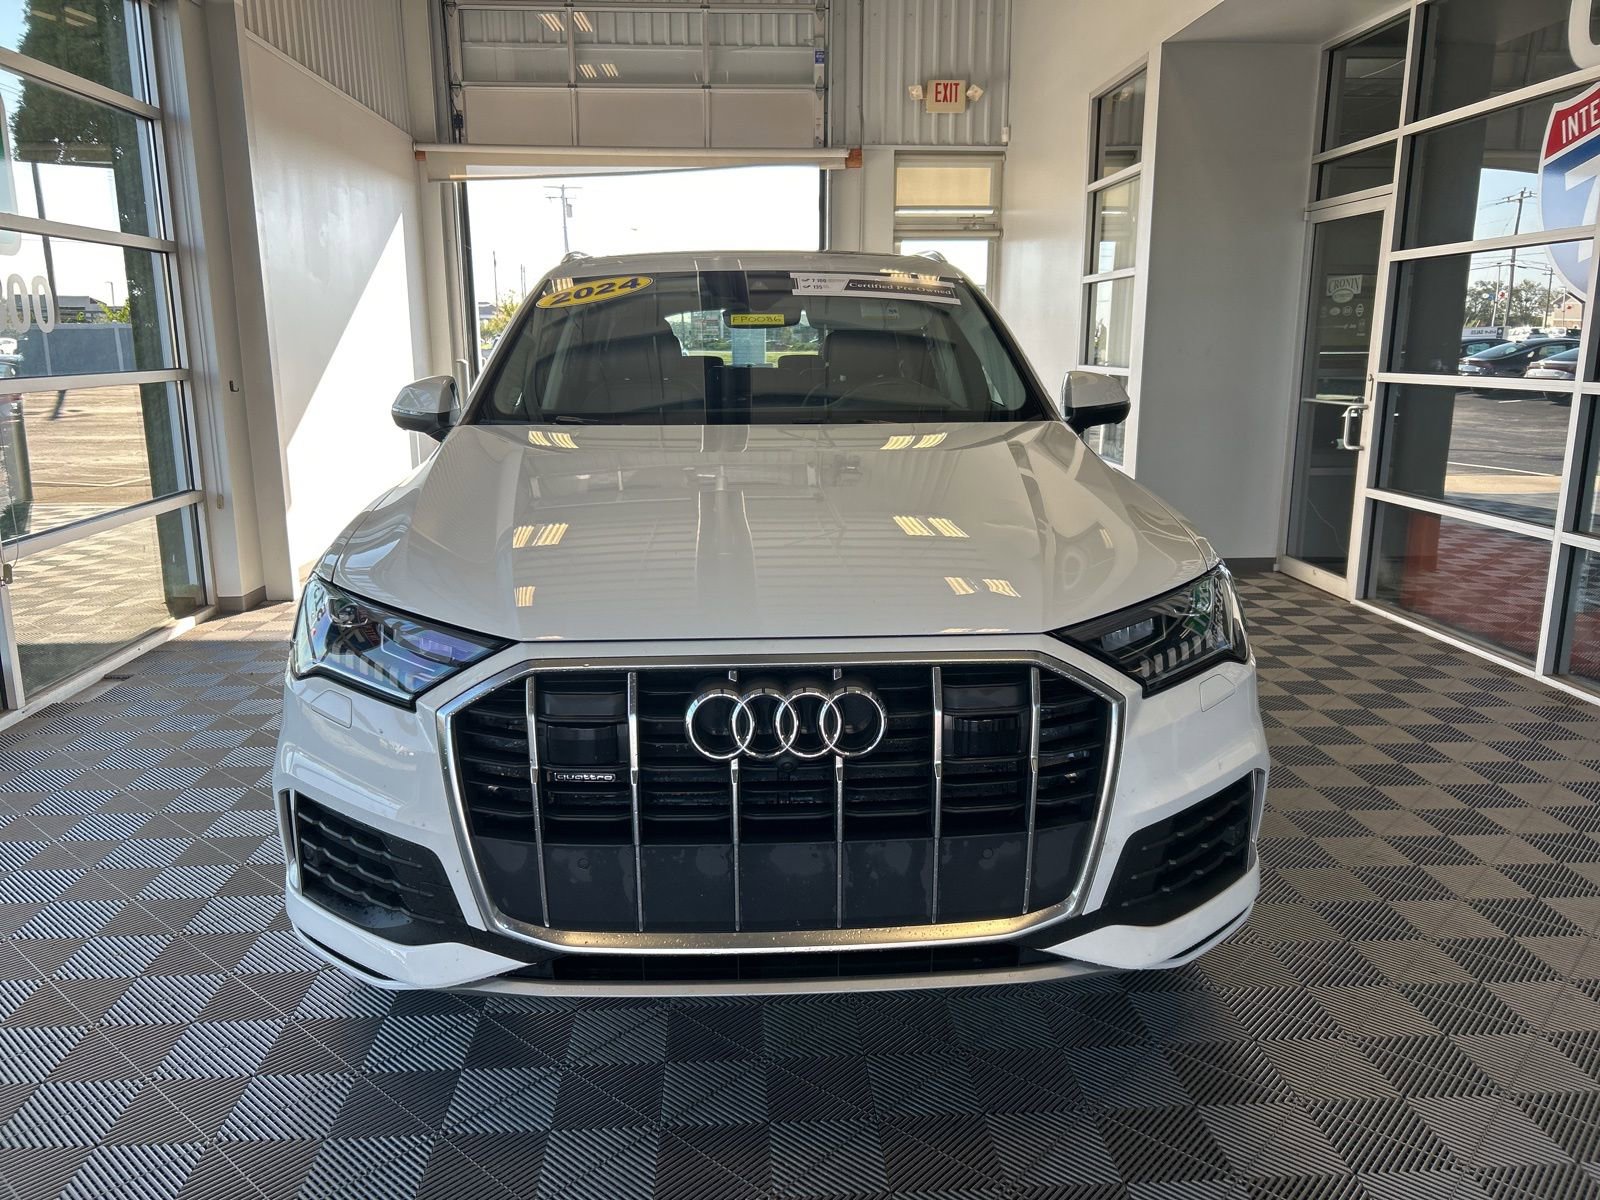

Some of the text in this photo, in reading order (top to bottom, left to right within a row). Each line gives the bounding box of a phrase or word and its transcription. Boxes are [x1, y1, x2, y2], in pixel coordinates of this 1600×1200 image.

[934, 82, 960, 103] EXIT
[1561, 98, 1600, 145] INTE
[550, 278, 640, 305] 2024
[849, 282, 952, 295] Certified Pre-Owned
[1327, 276, 1362, 294] CRONIN
[0, 273, 55, 333] 00
